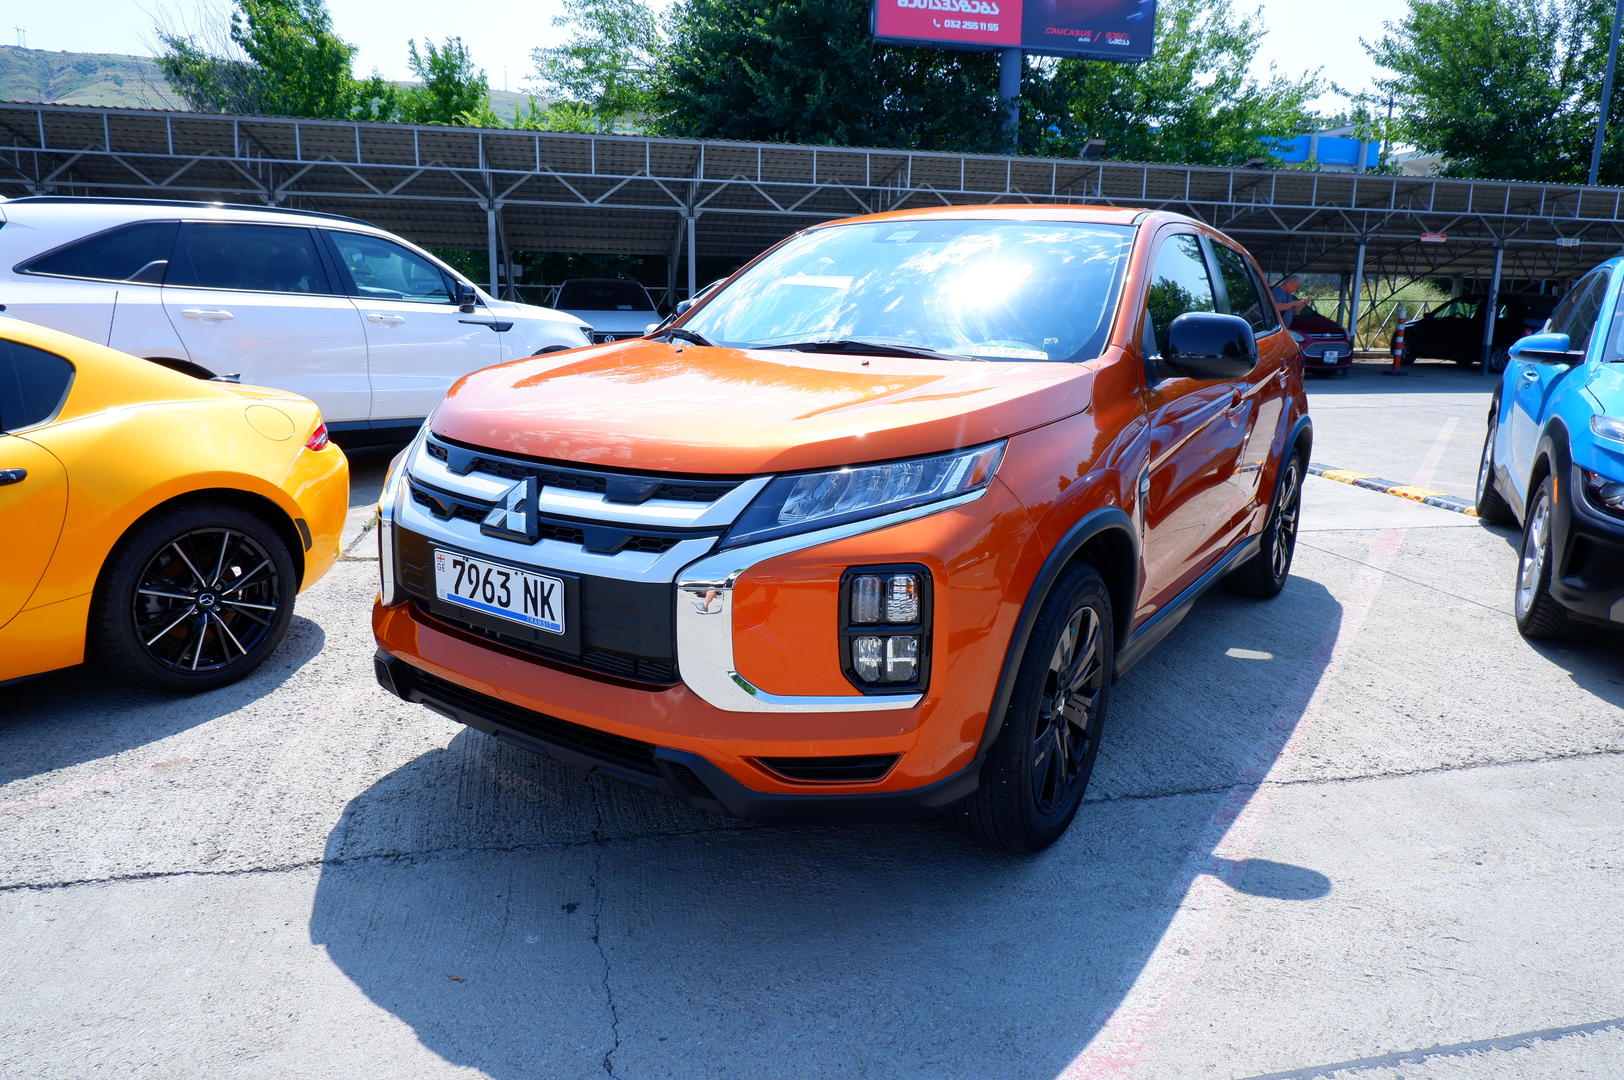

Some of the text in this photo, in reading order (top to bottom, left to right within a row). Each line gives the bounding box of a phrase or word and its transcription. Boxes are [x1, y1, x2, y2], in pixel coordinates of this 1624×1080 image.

[944, 19, 999, 32] 032 255 11 55
[1044, 26, 1092, 37] CAUCASUS
[437, 562, 446, 573] GE
[452, 559, 556, 622] 7963 NK
